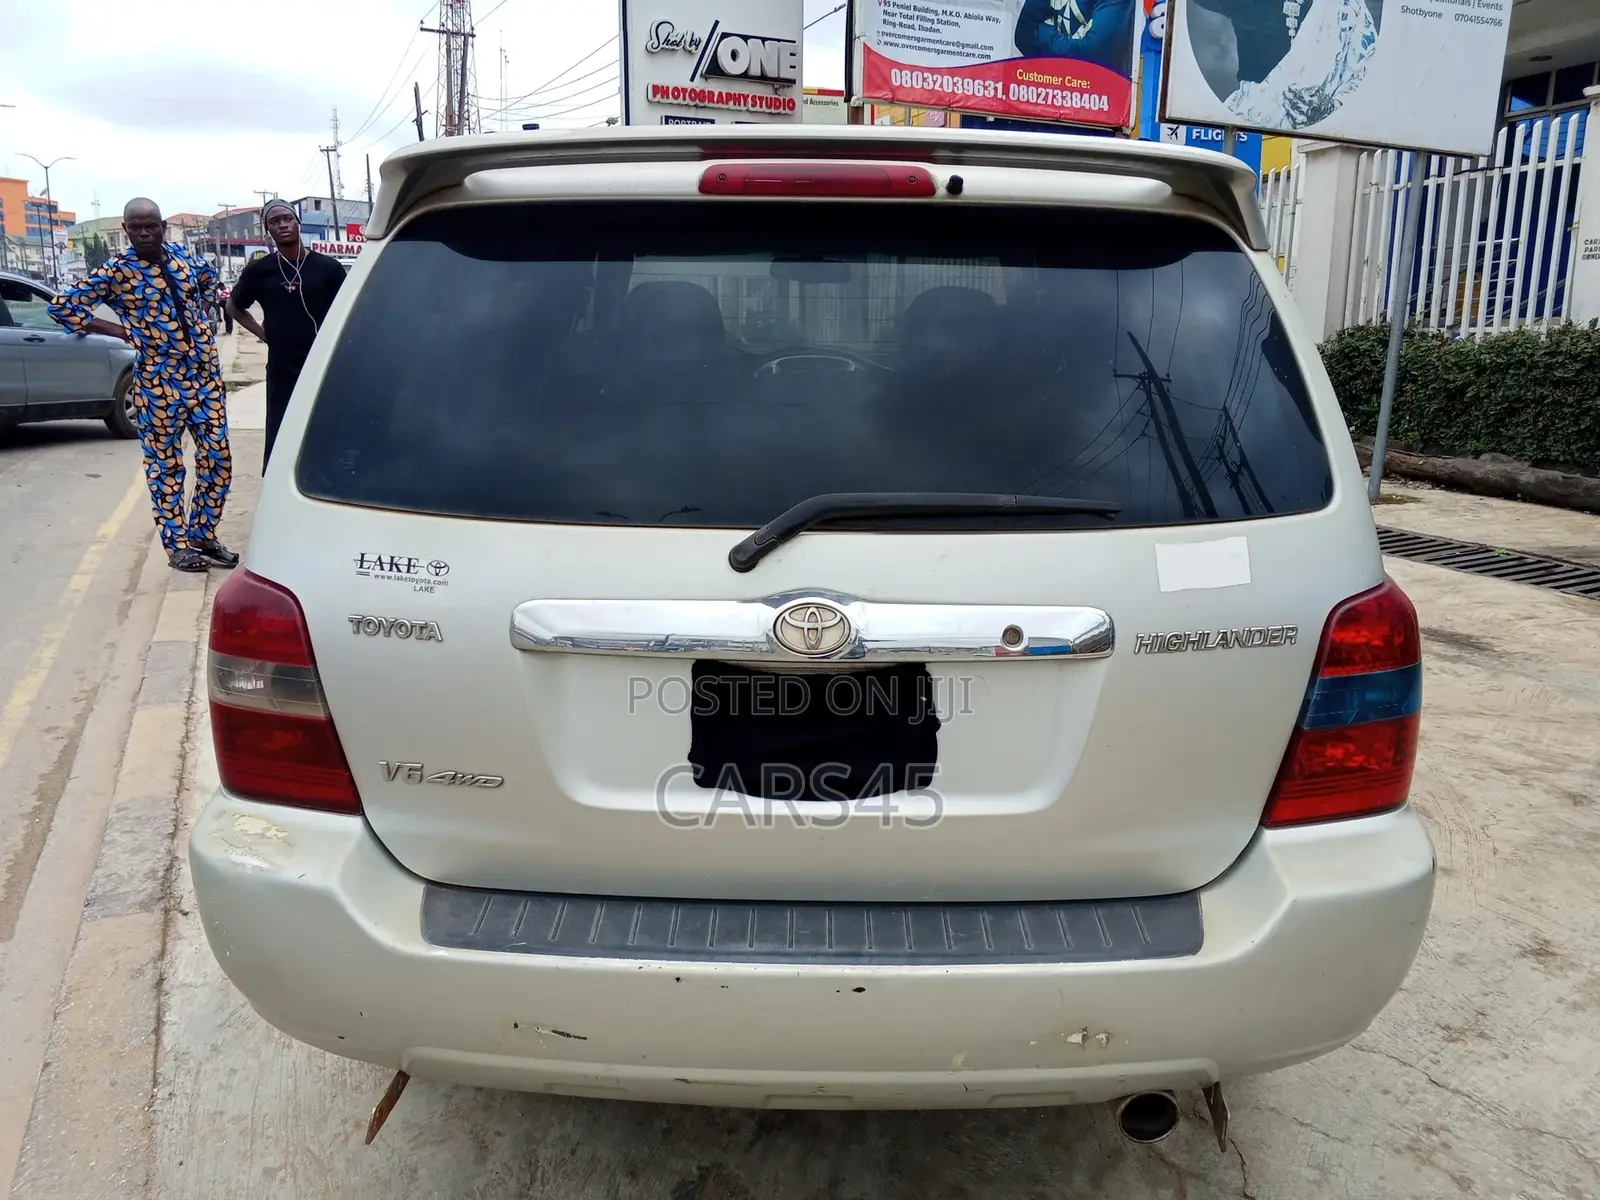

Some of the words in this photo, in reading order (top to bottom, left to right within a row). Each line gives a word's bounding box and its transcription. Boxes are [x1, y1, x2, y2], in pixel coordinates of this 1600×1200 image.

[893, 1, 912, 11] Peniel
[913, 5, 940, 16] Building,
[941, 10, 962, 18] M.K.O.
[963, 12, 984, 21] Abiola
[985, 15, 1001, 24] Way,
[1400, 5, 1443, 19] Shotbyone
[1454, 13, 1503, 27] 07041554766
[1477, 2, 1503, 11] Events
[882, 18, 917, 31] Ring-Road,
[918, 24, 942, 34] Ibadan.
[883, 9, 897, 18] Near
[899, 12, 915, 21] Total
[916, 15, 935, 25] Filling
[936, 18, 961, 28] Station,
[881, 31, 994, 51] overcomersgarmentcare@gmail.com
[883, 41, 992, 60] www.overcomersgarmentcare.com
[716, 36, 797, 80] ONE
[1016, 69, 1063, 86] Customer
[1065, 76, 1091, 89] Care:
[891, 68, 1006, 100] 08032039631,
[1009, 85, 1109, 111] 08027338404
[750, 94, 796, 111] STUDIO
[810, 98, 839, 107] Accessories
[354, 552, 424, 576] LAKE
[373, 573, 449, 587] www.laketoyota.com
[413, 585, 435, 594] LAKE
[348, 614, 443, 642] TOYOTA
[1134, 624, 1299, 654] HIGHLANDER
